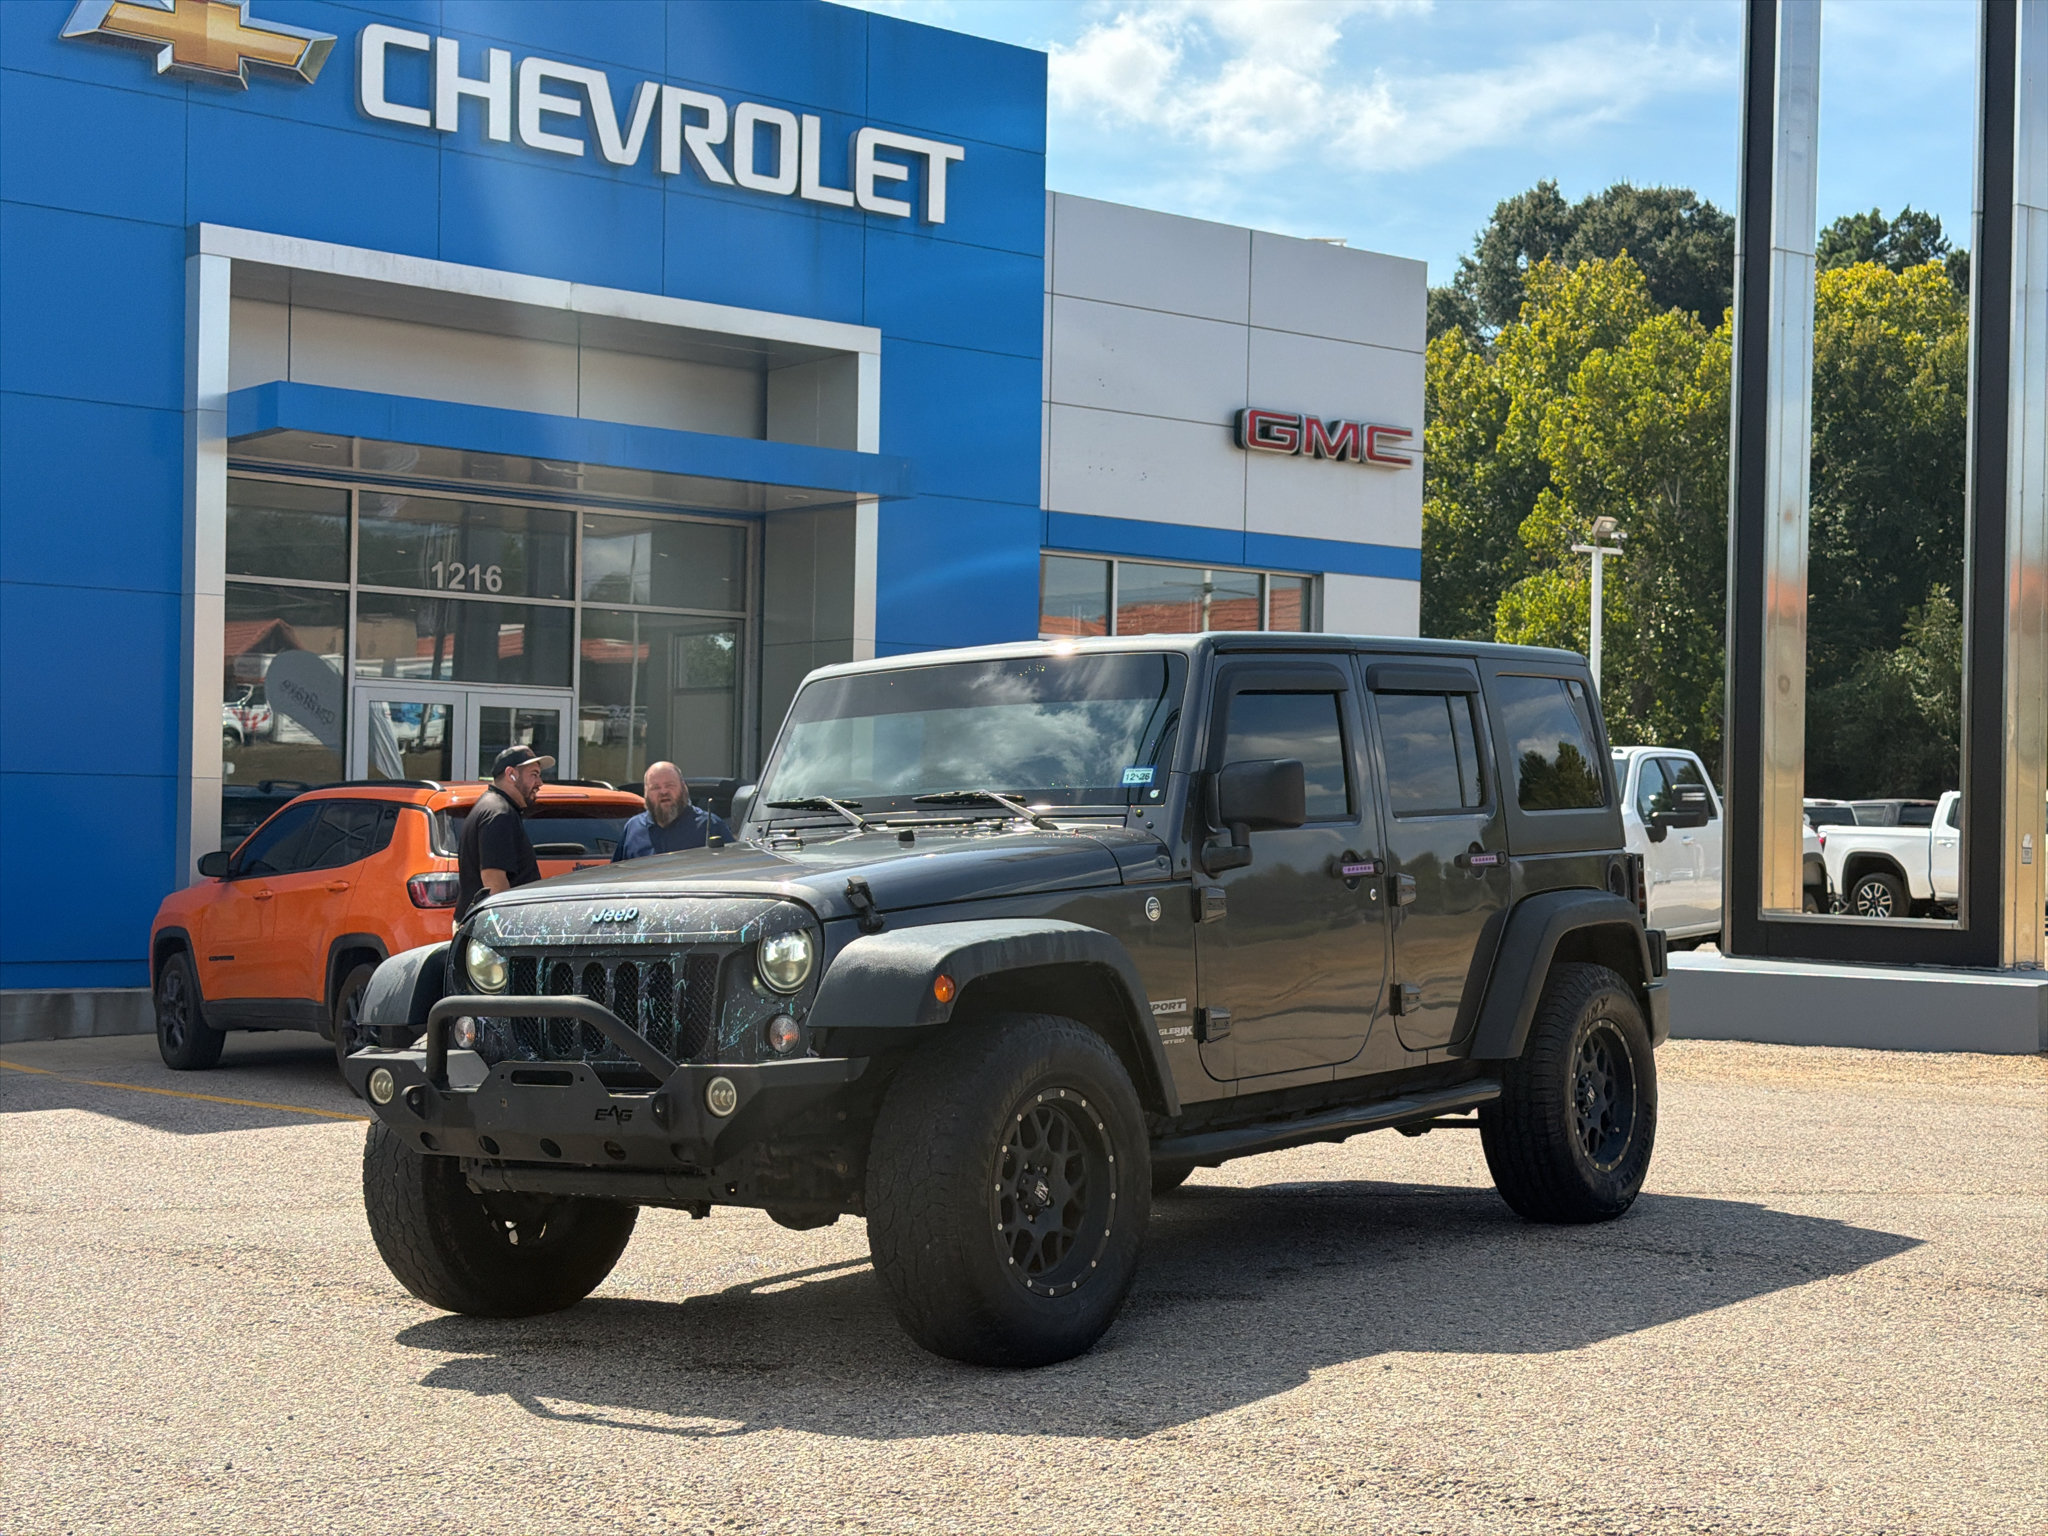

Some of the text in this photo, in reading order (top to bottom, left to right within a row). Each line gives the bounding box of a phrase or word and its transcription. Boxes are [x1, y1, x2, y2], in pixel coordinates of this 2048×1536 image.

[357, 22, 965, 225] CHEVROLET
[1238, 407, 1414, 469] GMC
[431, 561, 503, 593] 1216
[591, 907, 639, 924] Jeep
[1150, 1000, 1187, 1012] PORT
